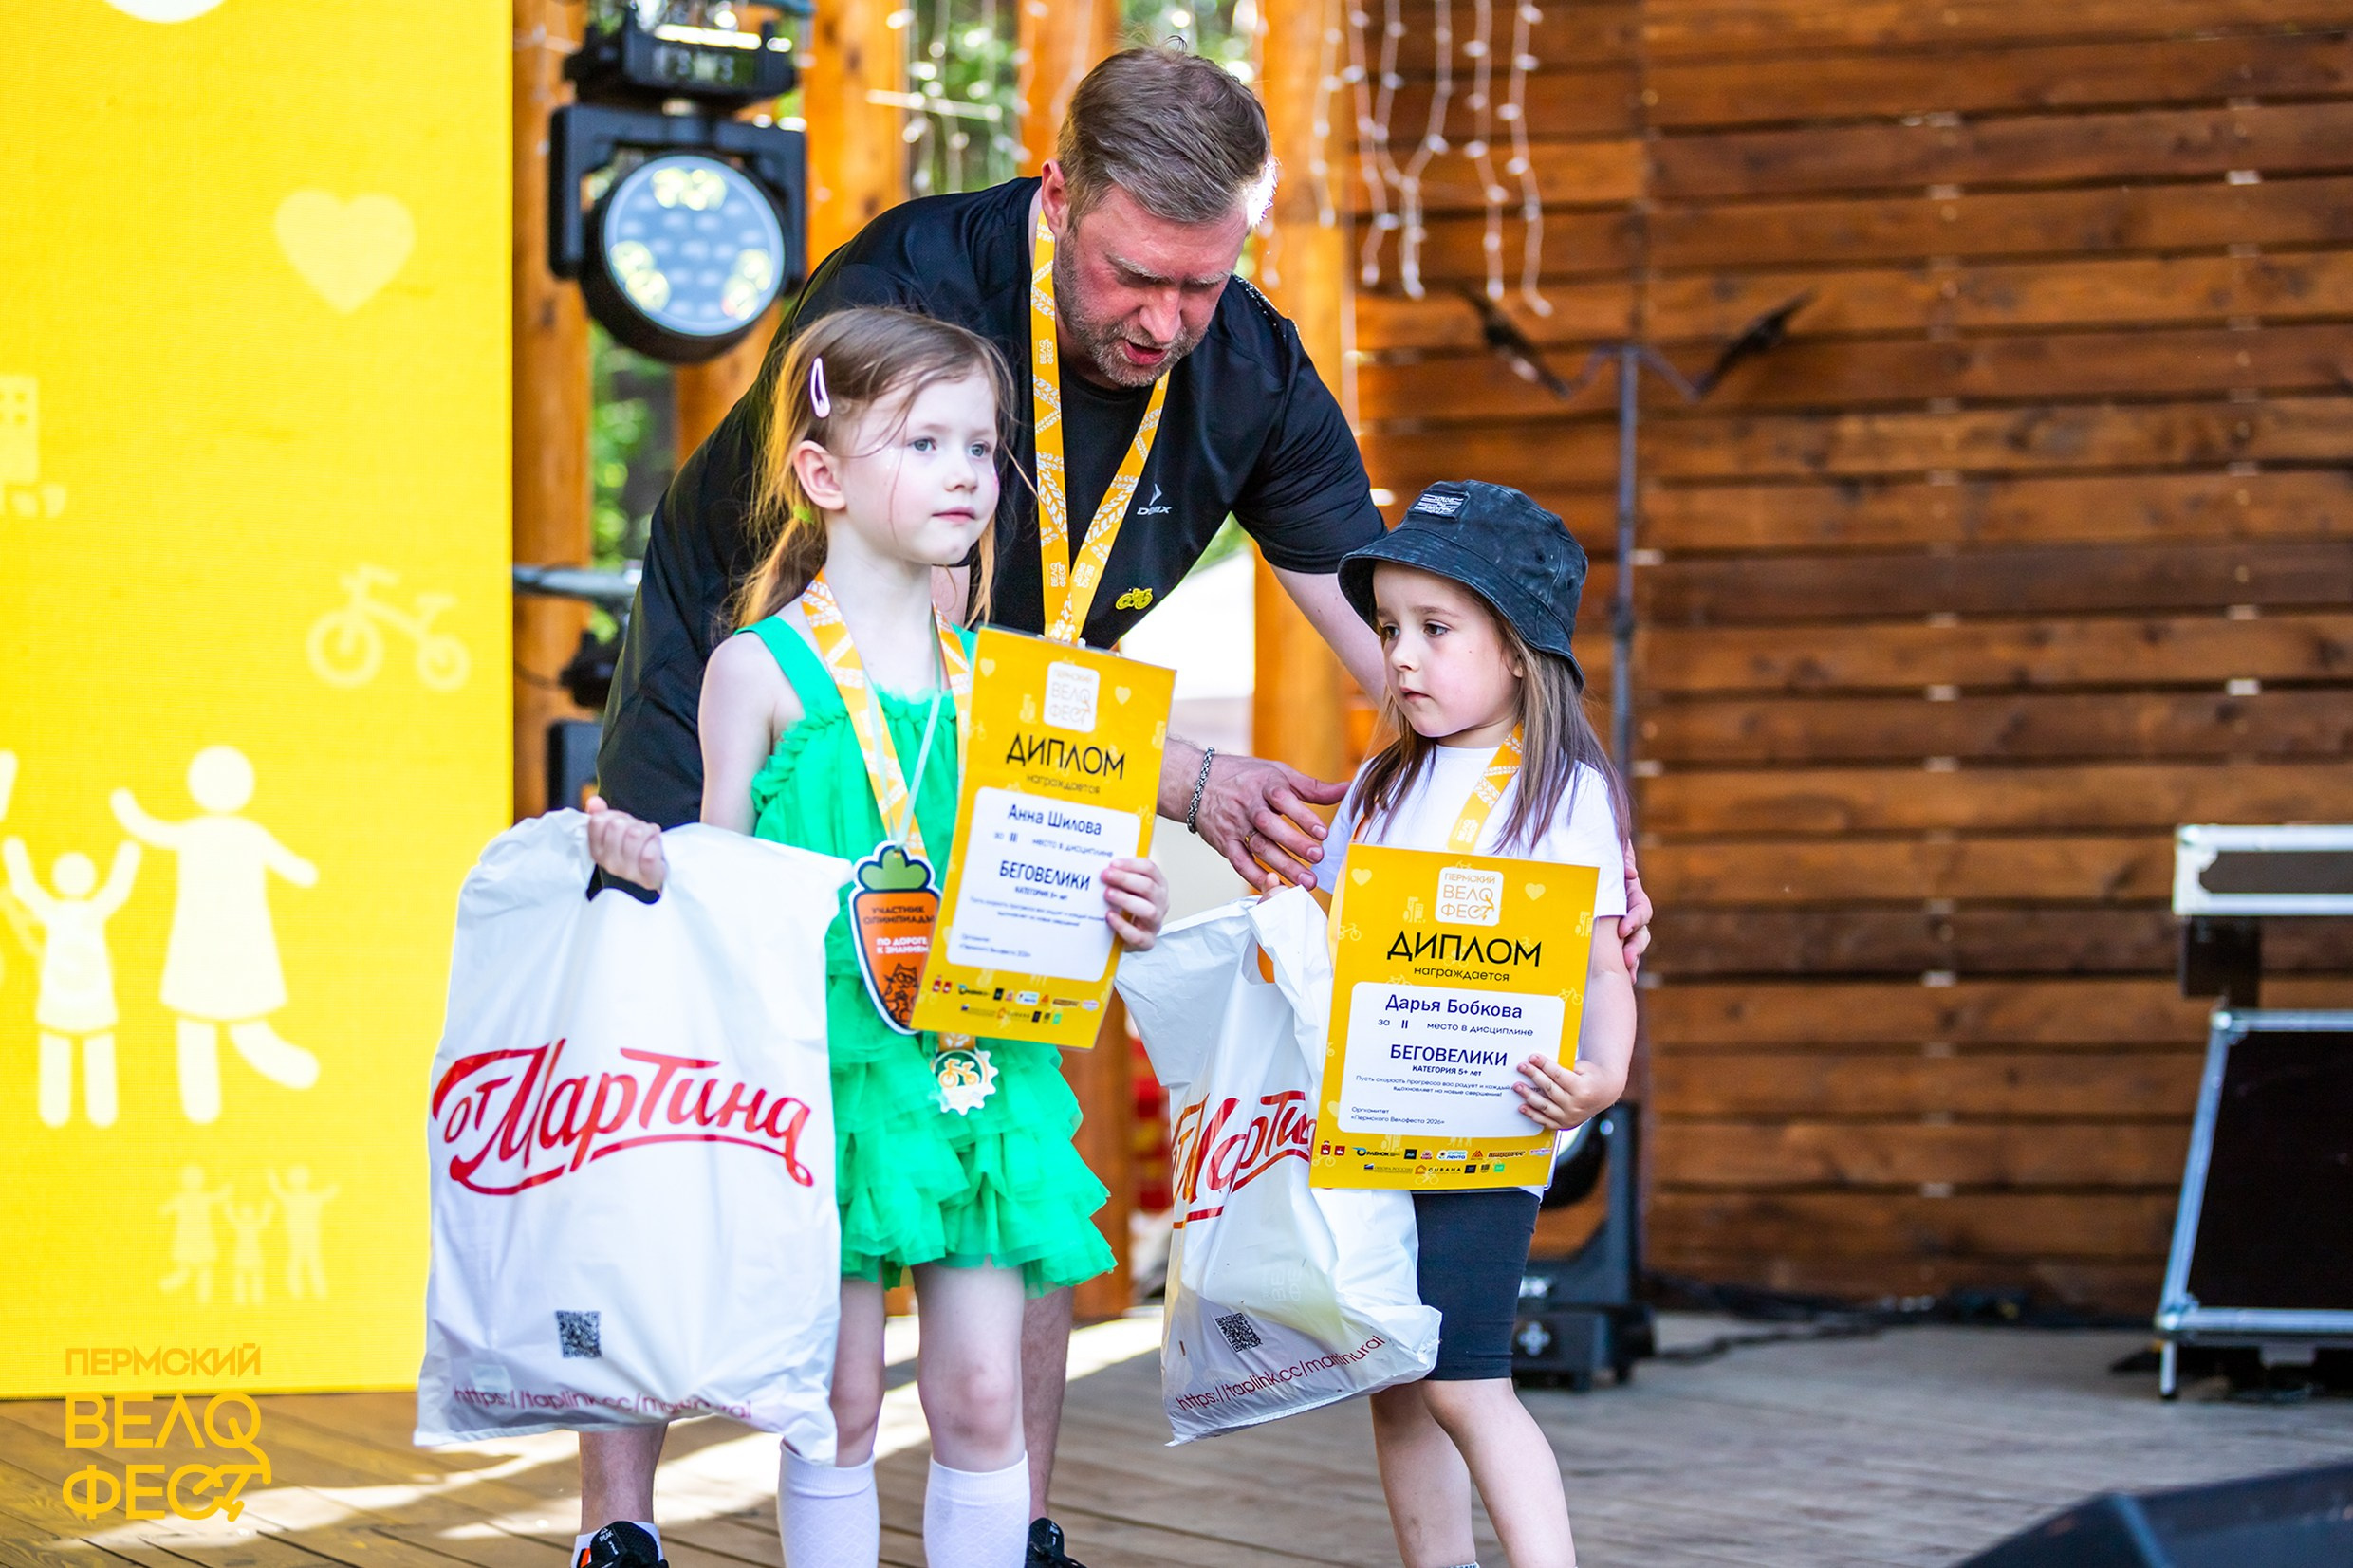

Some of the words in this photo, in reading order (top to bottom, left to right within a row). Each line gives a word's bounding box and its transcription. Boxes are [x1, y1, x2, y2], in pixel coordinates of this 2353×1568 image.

[1006, 732, 1125, 780] ДИПЛОМ
[1008, 803, 1044, 824] Анна
[1047, 811, 1102, 836] Шилова
[999, 860, 1091, 891] БЕГОВЕЛИКИ
[1444, 873, 1496, 884] ПЕРМСКИЙ
[1443, 884, 1494, 902] ВЕЛО
[1440, 903, 1494, 921] ФЕСТ
[1386, 930, 1542, 968] ДИПЛОМ
[1414, 966, 1510, 982] награждается
[1385, 993, 1441, 1014] Дарья
[1447, 998, 1523, 1019] Бобкова
[1401, 1020, 1409, 1029] II
[1427, 1023, 1459, 1032] место
[1470, 1025, 1534, 1037] дисциплине
[1390, 1044, 1508, 1067] БЕГОВЕЛИКИ
[1412, 1064, 1456, 1075] КАТЕГОРИЯ
